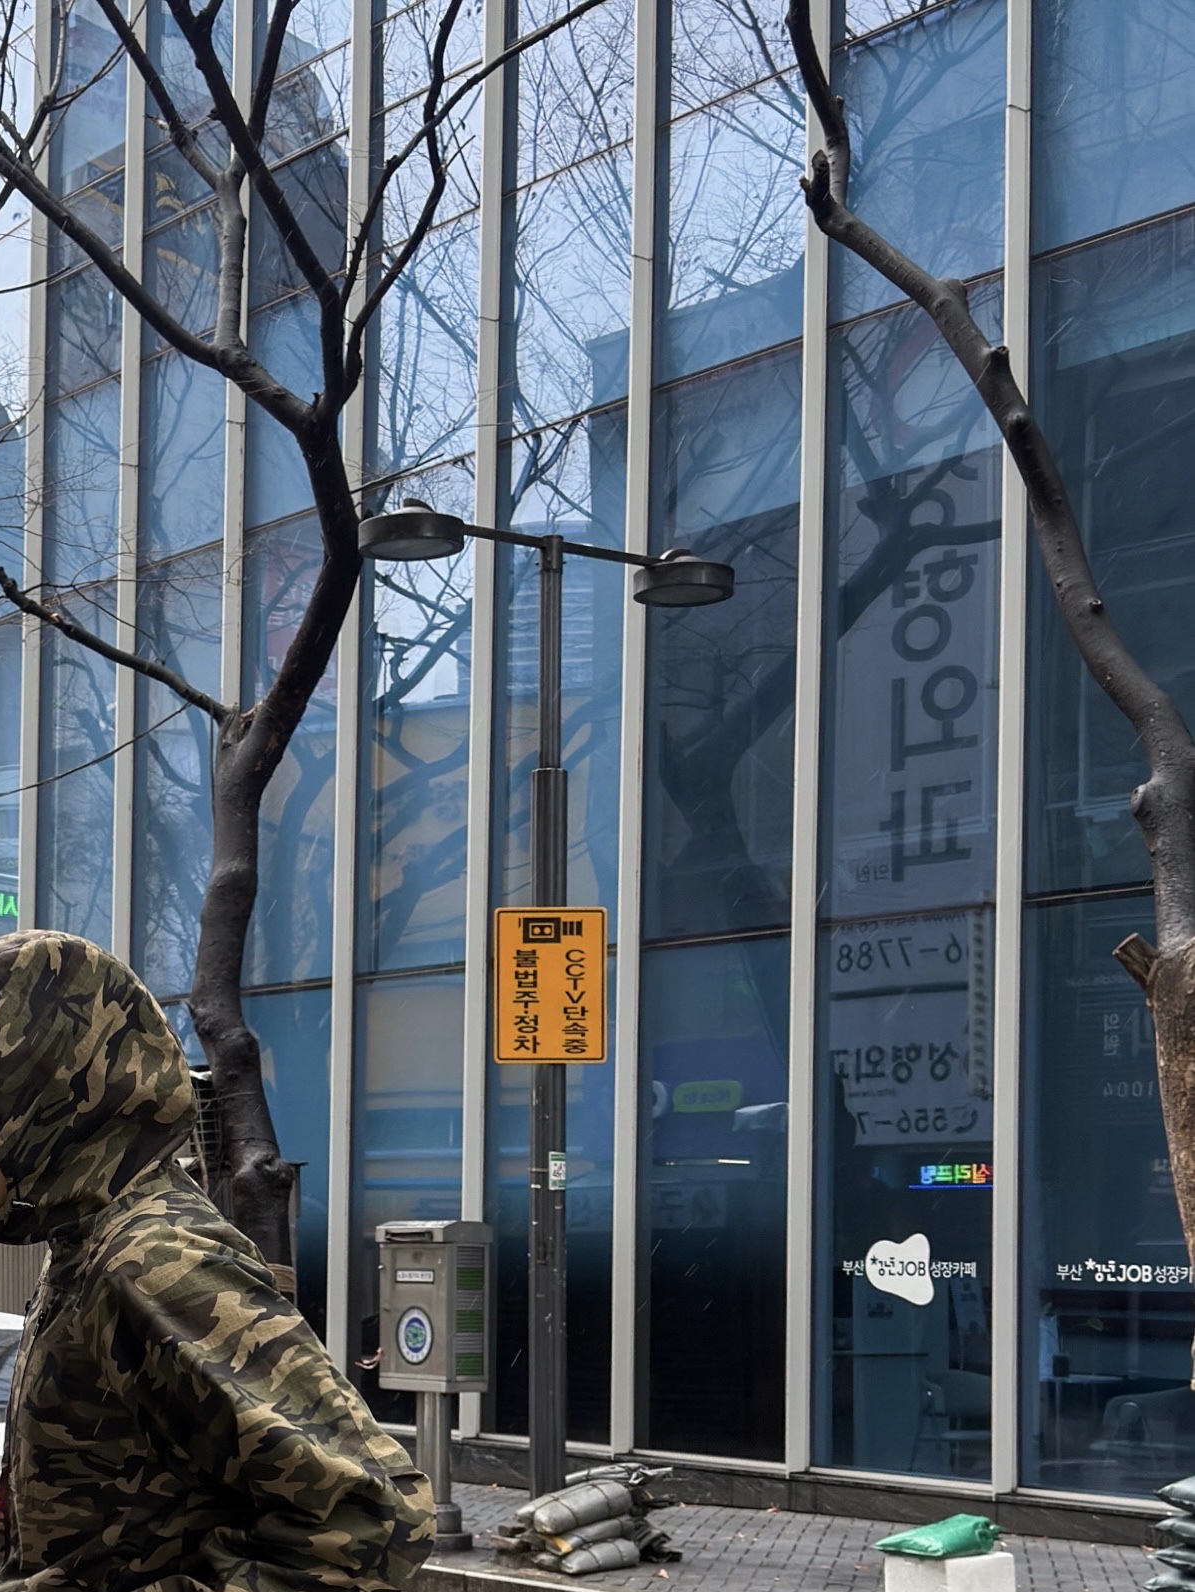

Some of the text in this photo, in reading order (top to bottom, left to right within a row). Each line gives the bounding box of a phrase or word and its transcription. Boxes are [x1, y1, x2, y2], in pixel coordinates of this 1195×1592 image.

[842, 1260, 865, 1276] 부산
[930, 1261, 977, 1278] 성장카페
[1056, 1264, 1083, 1281] 부산
